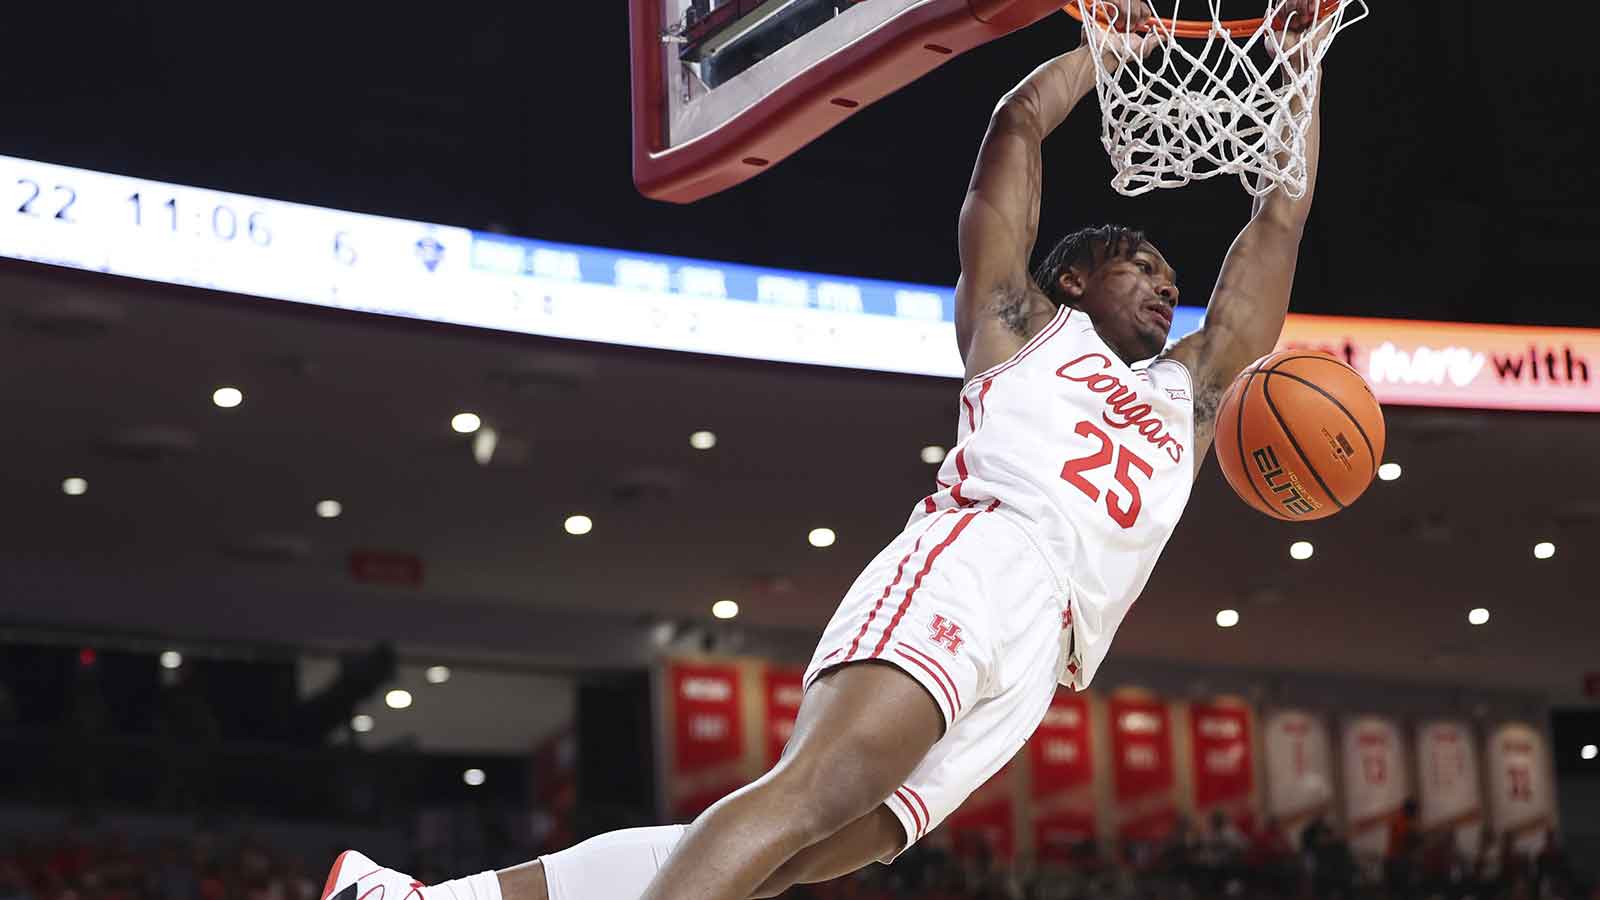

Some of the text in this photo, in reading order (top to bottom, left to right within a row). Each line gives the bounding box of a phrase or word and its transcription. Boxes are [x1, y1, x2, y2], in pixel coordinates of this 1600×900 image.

[16, 178, 357, 266] 22 11:06 6
[1056, 353, 1184, 464] Cougars
[1493, 347, 1591, 382] with
[1060, 420, 1153, 529] 25
[1252, 445, 1315, 516] ELITE
